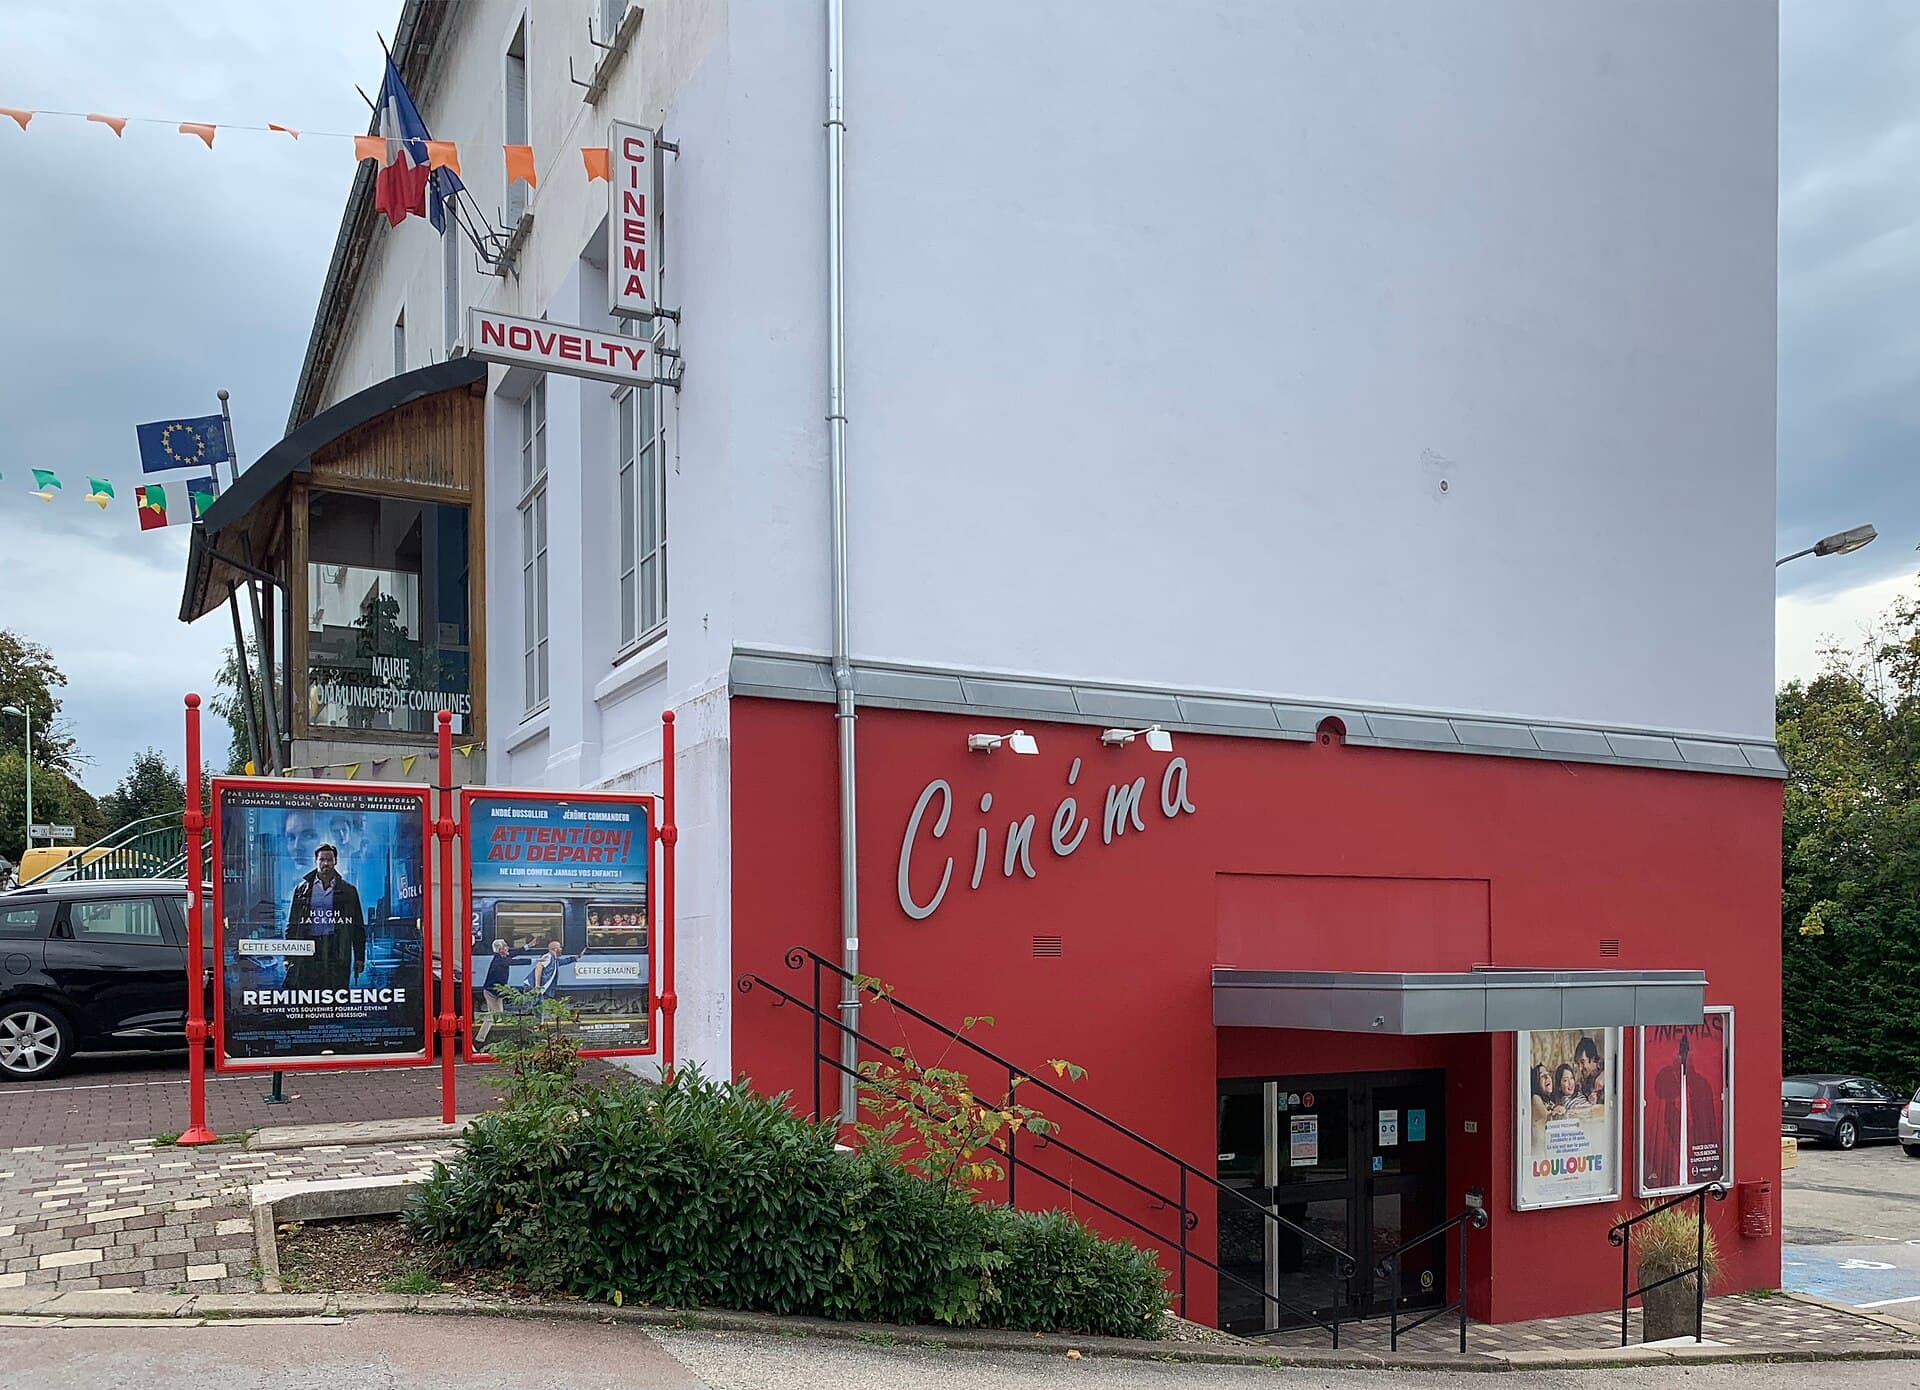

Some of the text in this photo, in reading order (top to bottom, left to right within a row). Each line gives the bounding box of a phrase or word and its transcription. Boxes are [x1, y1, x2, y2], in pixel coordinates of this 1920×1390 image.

[623, 136, 646, 300] CINEMA
[481, 320, 646, 372] NOVELTY
[372, 656, 410, 678] MAIRIE
[316, 685, 471, 714] OMMUNAUTE DE COMMUNES
[491, 806, 630, 822] ANDRÉ DUSSOLLIER JÉRÔME COMMANDEUR
[490, 824, 622, 846] ATTENTION
[897, 756, 1196, 920] Cinéma
[488, 845, 520, 861] AU
[242, 943, 312, 952] CETTE SEMAINE
[578, 966, 602, 974] CETTE
[243, 988, 406, 1006] REMINISCENCE
[1533, 1155, 1602, 1177] LOULOUTE
